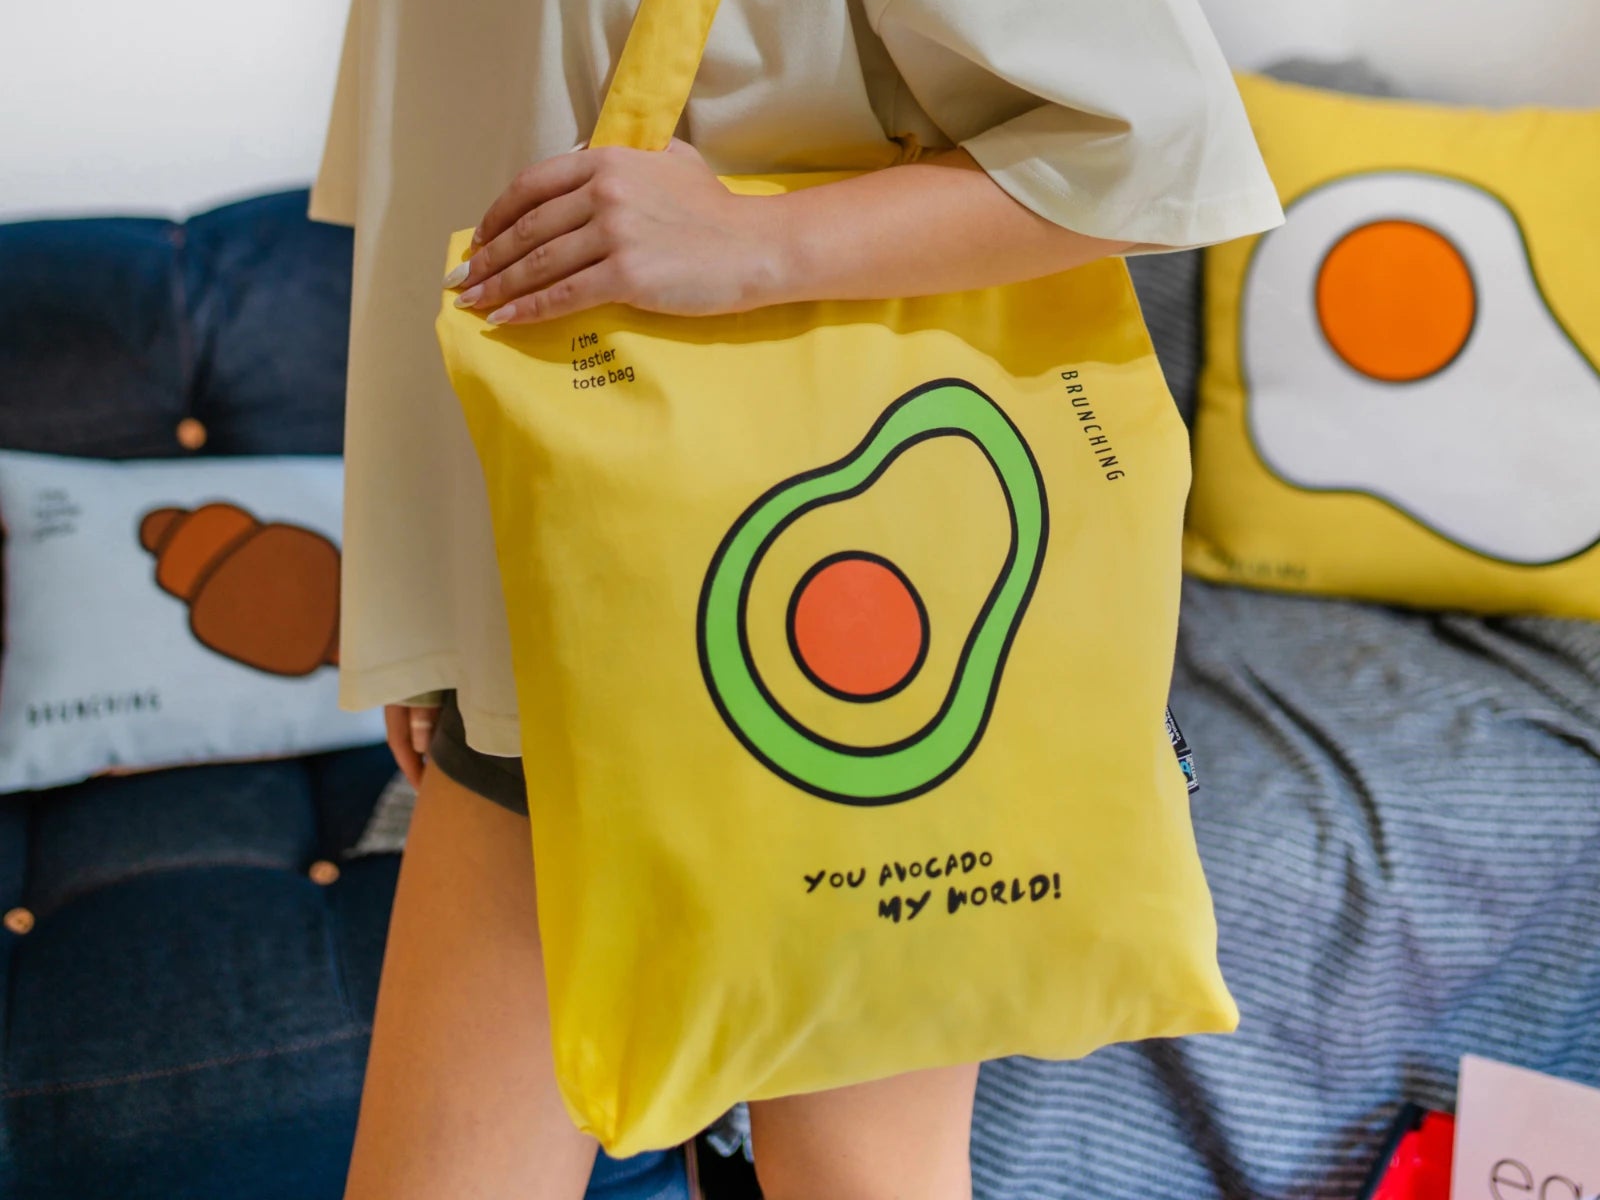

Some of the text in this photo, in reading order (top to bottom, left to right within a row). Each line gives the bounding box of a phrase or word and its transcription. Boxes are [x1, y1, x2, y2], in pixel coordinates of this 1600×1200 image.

[578, 332, 599, 349] the
[571, 348, 616, 372] tastier
[572, 365, 635, 390] tote bag
[1060, 370, 1126, 481] BRUNCHING
[803, 850, 994, 894] YOU AVOCADO
[877, 871, 1062, 924] MY WORLD!
